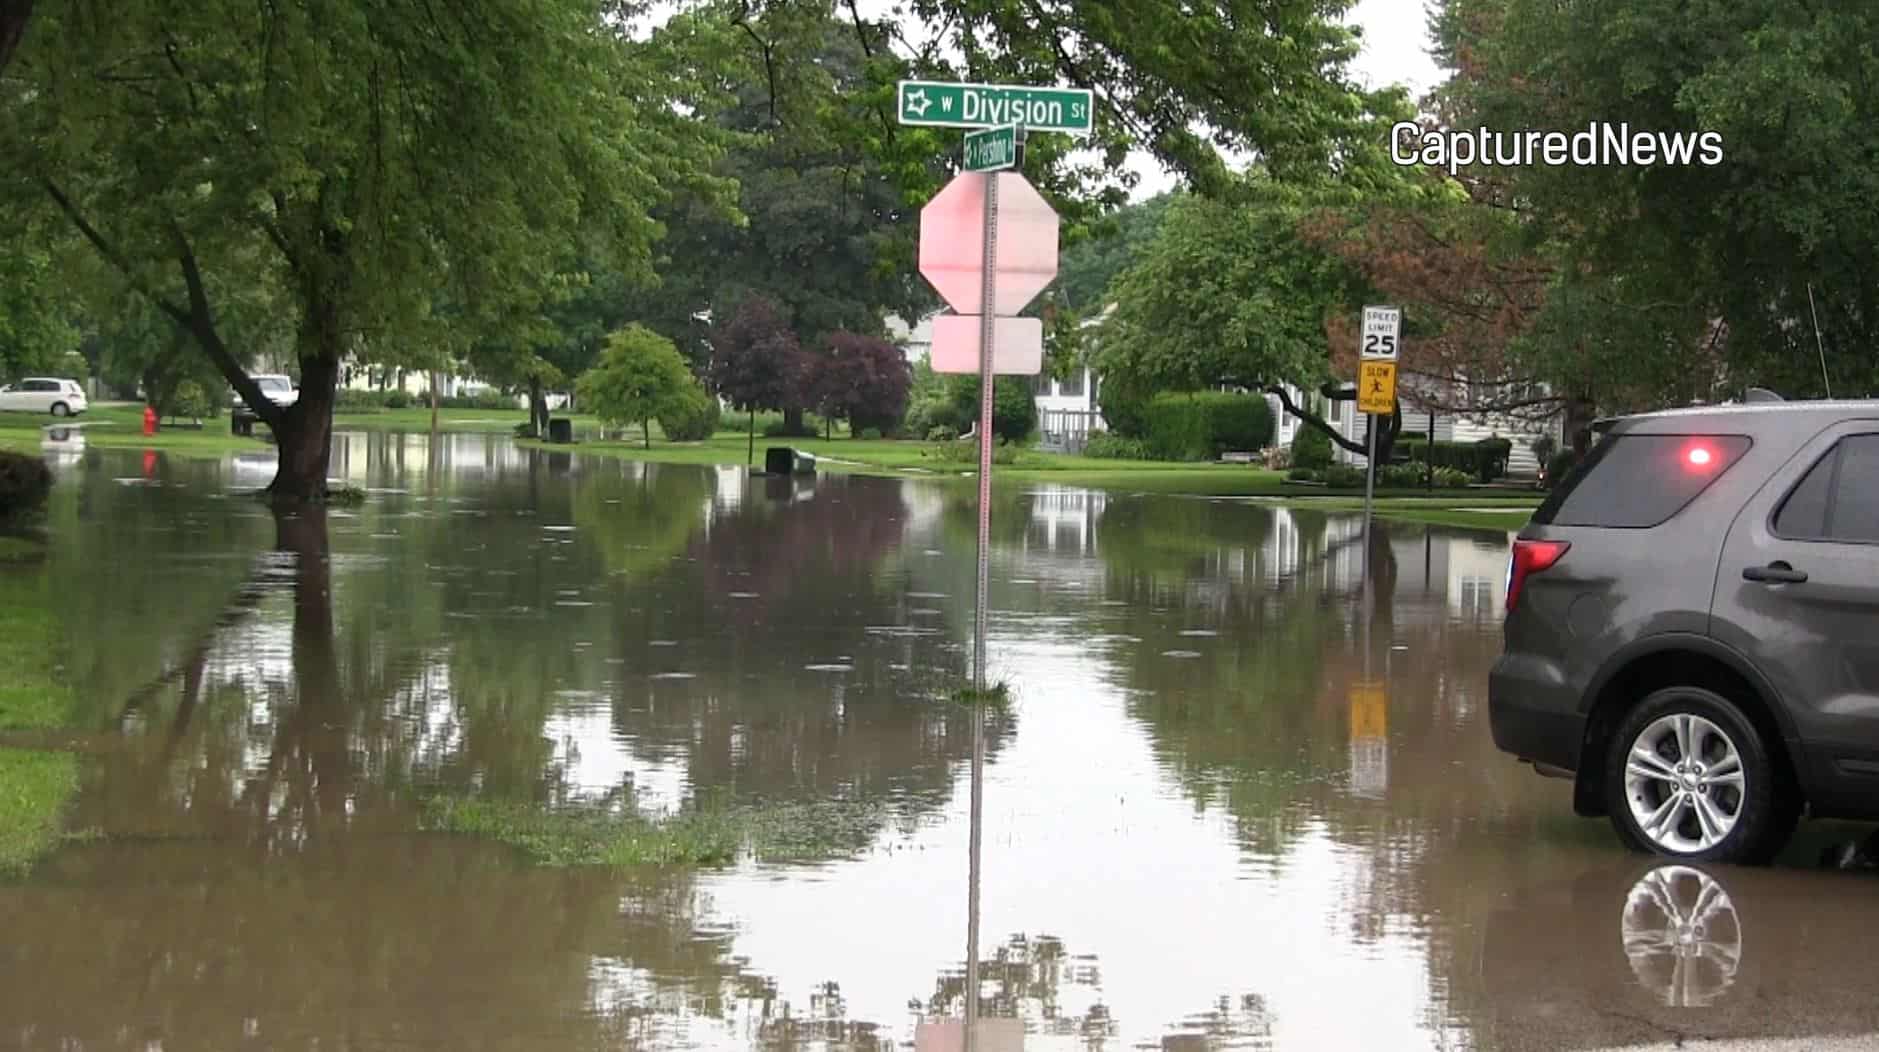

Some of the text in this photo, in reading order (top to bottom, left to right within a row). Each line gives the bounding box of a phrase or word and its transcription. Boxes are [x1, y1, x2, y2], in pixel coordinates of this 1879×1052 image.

[941, 90, 1086, 125] W Division St
[978, 132, 1006, 166] Pershing
[1366, 311, 1398, 322] SPEED
[1368, 323, 1393, 332] LIMIT
[1364, 335, 1395, 355] 25
[1366, 367, 1390, 377] SLOW
